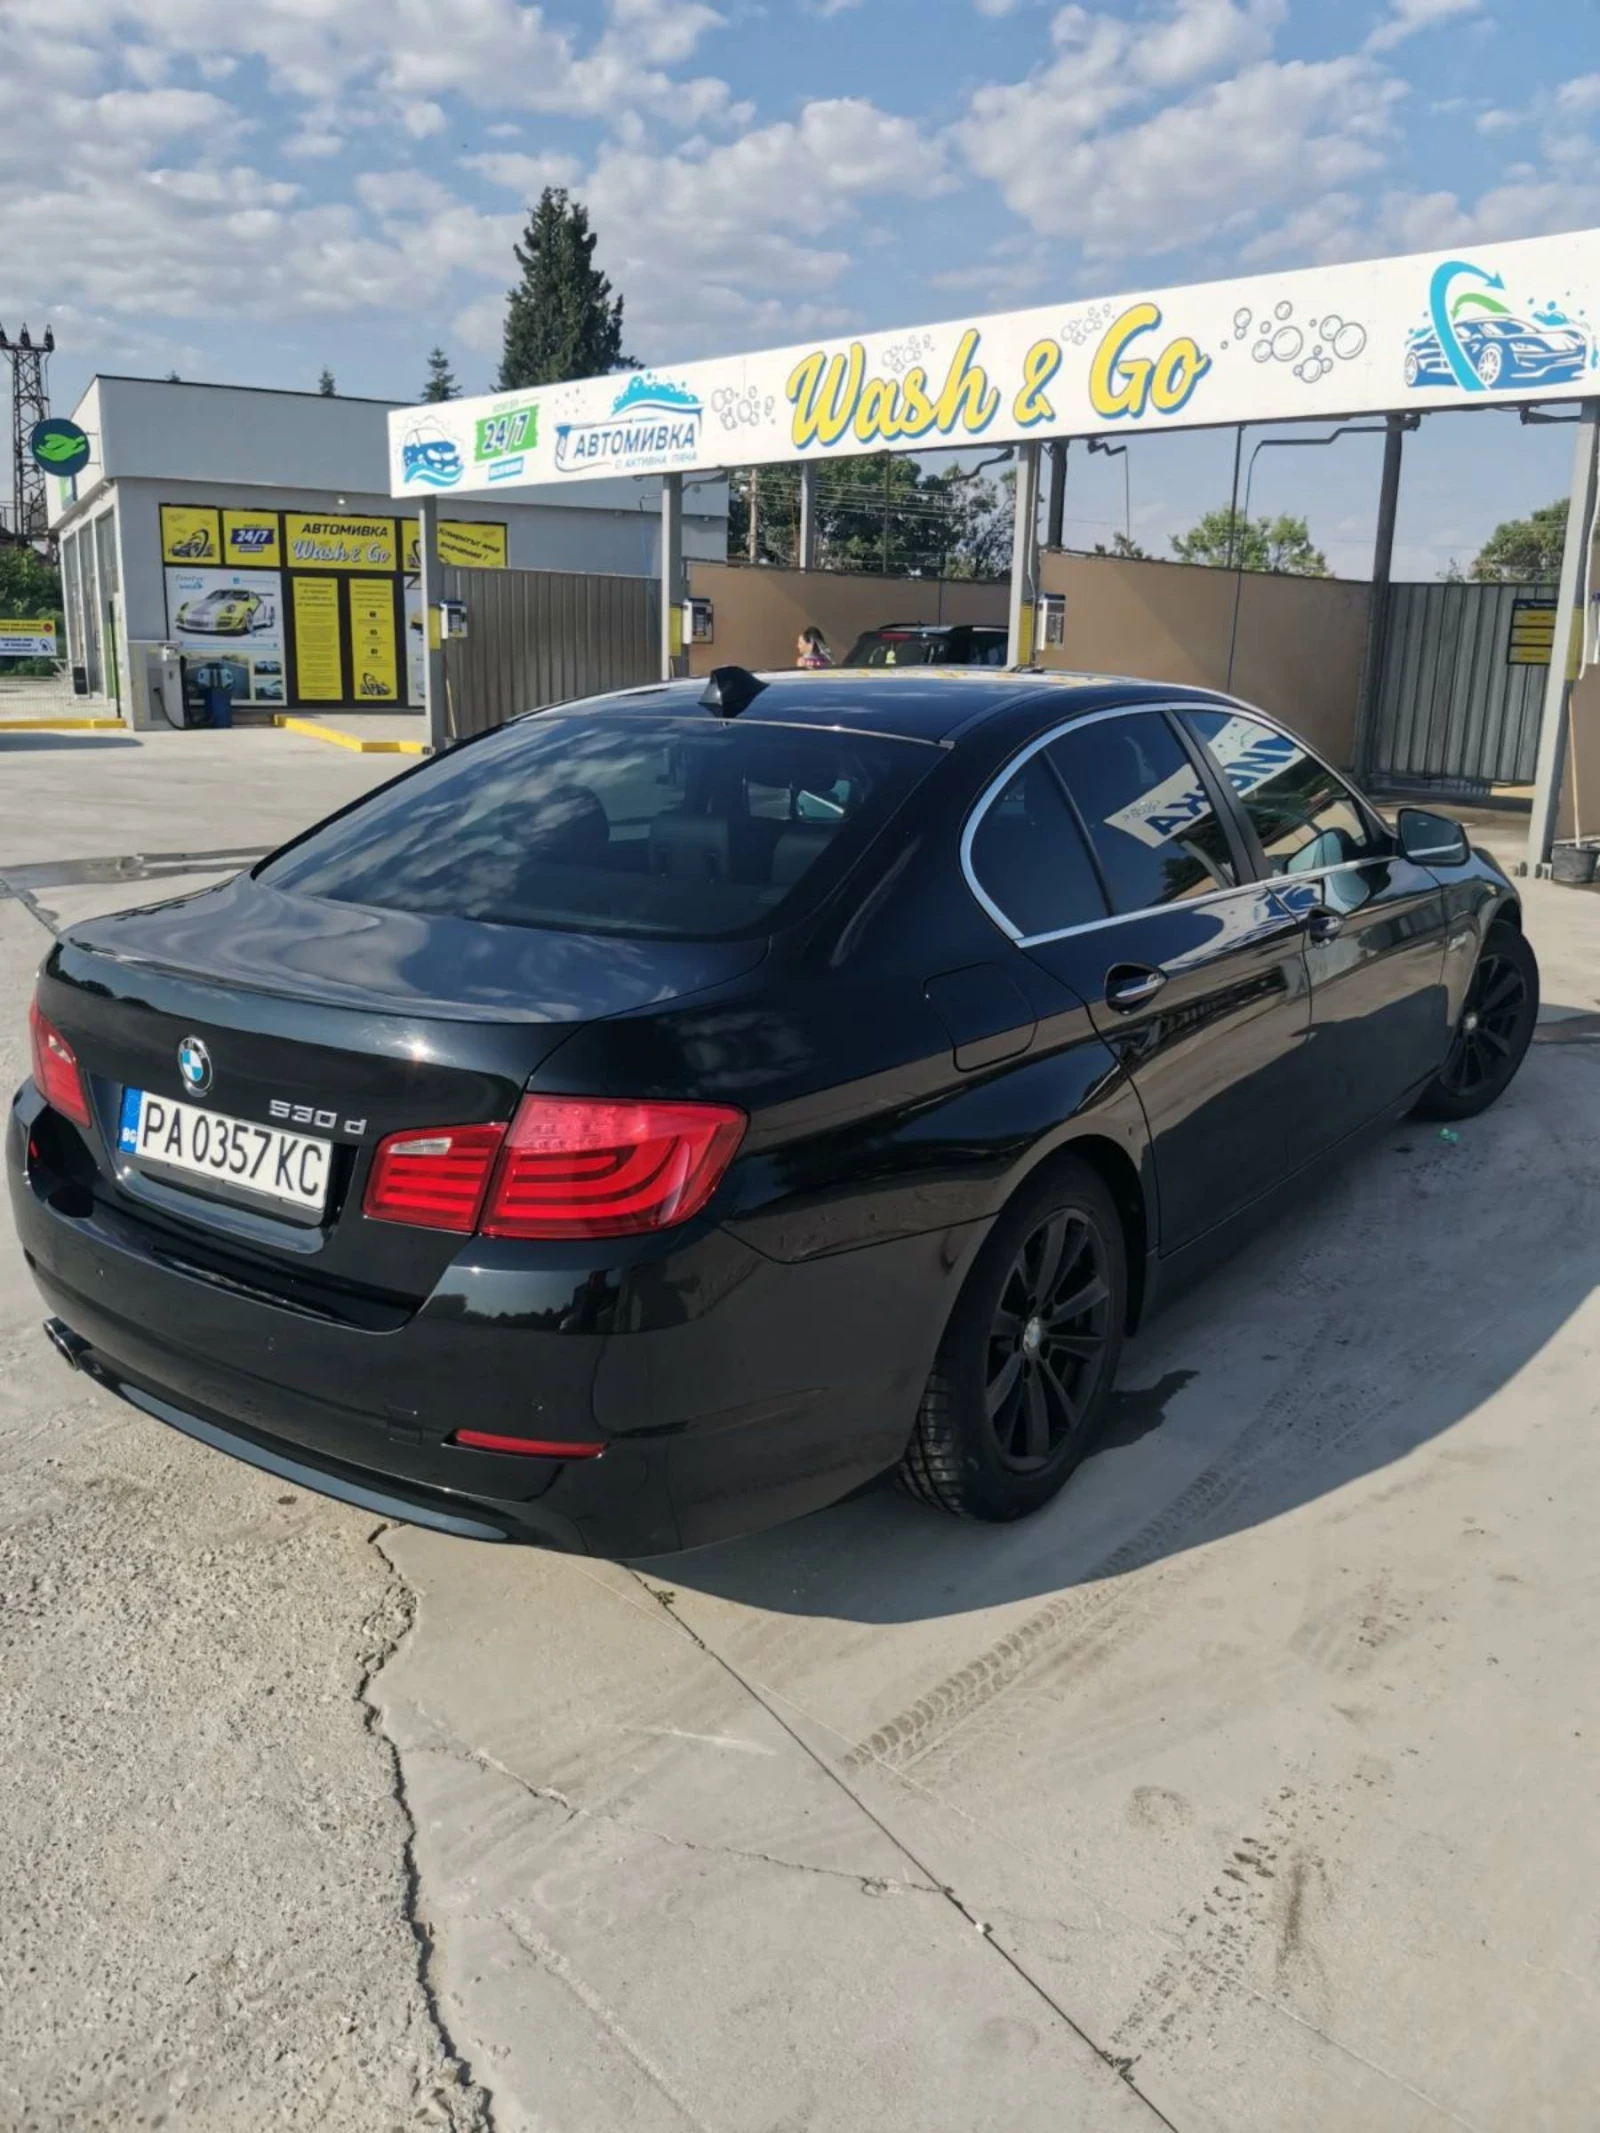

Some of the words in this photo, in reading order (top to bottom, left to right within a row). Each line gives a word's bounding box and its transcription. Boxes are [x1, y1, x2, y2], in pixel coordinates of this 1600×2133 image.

[786, 328, 1001, 450] Wash
[1012, 338, 1062, 427] &
[1088, 302, 1213, 421] Go
[483, 412, 530, 453] 24/7
[574, 422, 696, 460] АВТОМИВКА
[235, 529, 270, 545] 24/7
[301, 522, 388, 537] АВТОМИВКА
[293, 539, 349, 562] Wash
[367, 541, 391, 564] Go
[269, 1099, 338, 1129] 530
[343, 1118, 368, 1136] d
